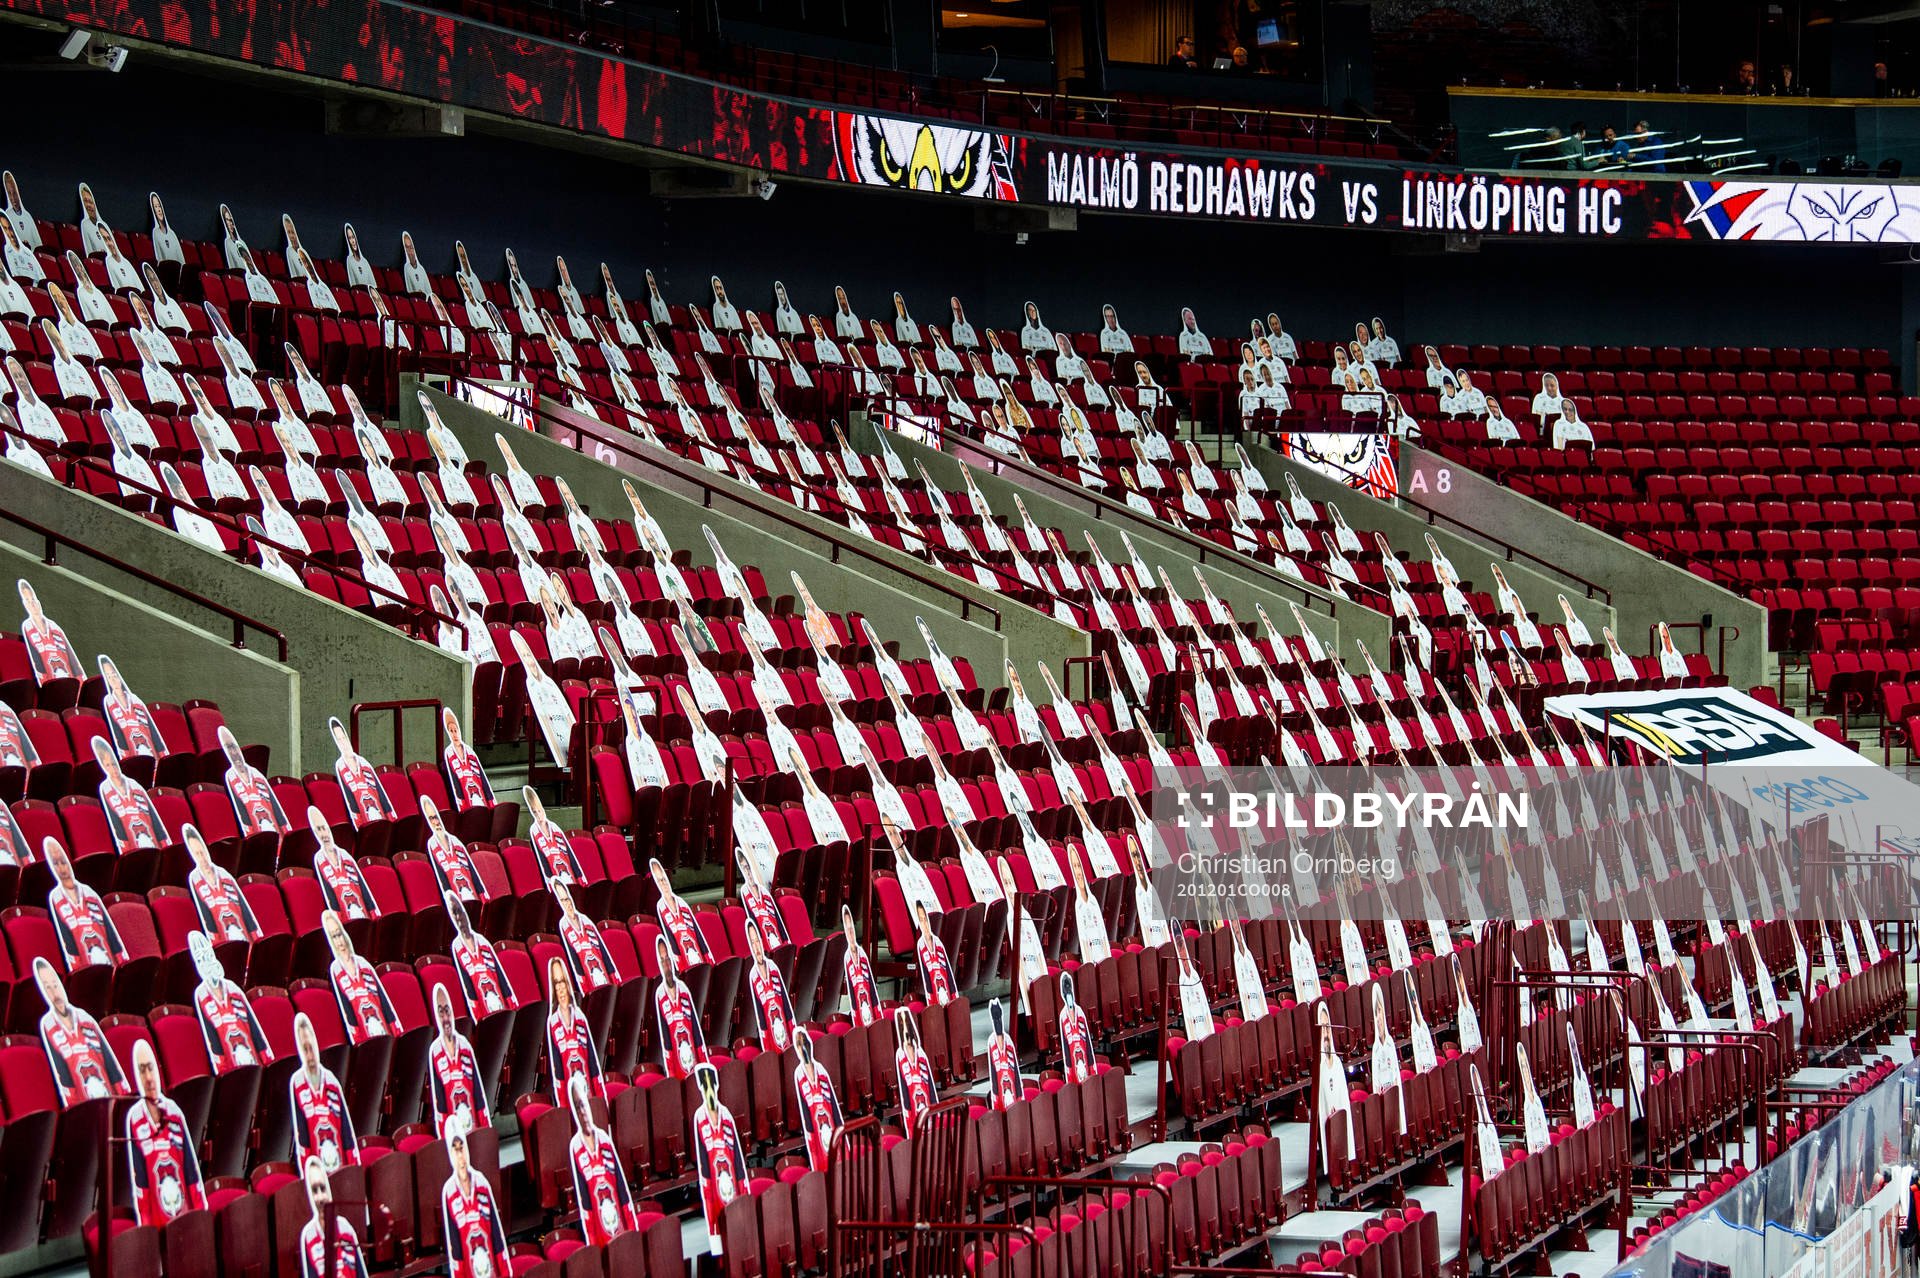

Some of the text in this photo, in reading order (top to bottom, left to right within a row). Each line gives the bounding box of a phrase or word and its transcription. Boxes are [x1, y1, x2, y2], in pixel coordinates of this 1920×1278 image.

[1047, 150, 1622, 234] MALMÖ REDHAWKS VS LINKÖPING HC
[1408, 468, 1451, 494] A 8
